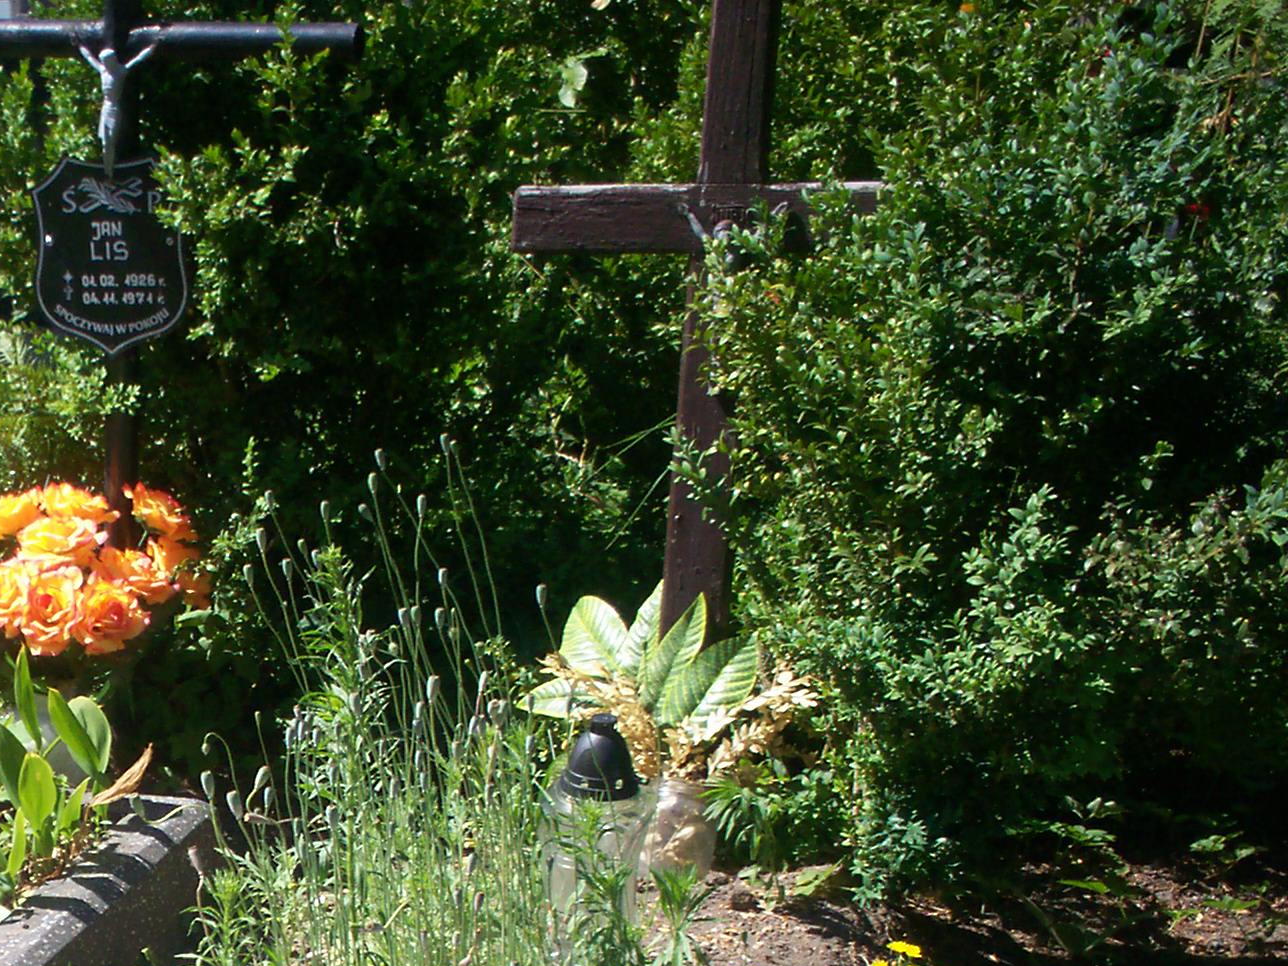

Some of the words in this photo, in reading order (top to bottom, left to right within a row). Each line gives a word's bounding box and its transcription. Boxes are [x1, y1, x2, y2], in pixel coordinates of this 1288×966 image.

[91, 221, 122, 240] JAN
[90, 241, 129, 260] LIS
[55, 303, 114, 336] SPOCZYWAJ
[115, 322, 127, 335] W
[128, 307, 170, 333] POKOJU
